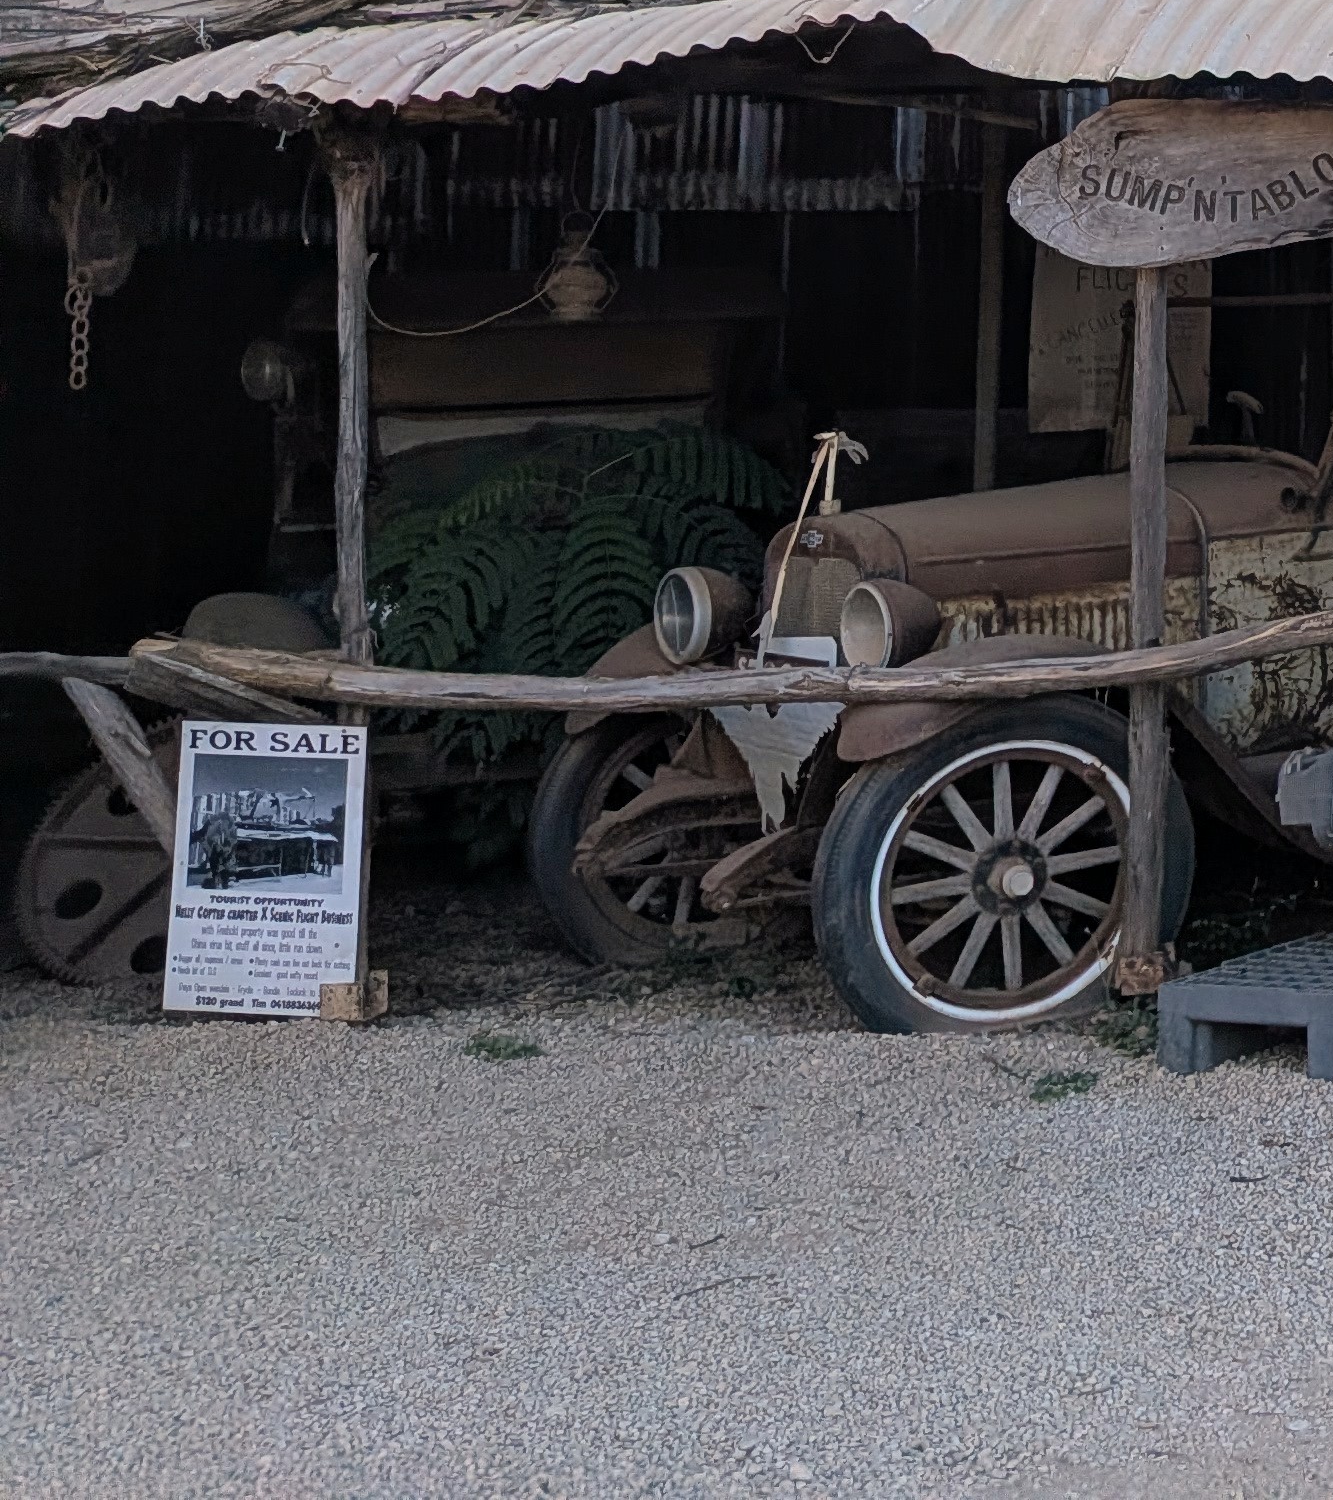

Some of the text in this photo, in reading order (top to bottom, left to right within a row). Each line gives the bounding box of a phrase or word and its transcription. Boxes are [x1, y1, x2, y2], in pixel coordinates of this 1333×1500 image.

[189, 729, 361, 754] FOR SALE
[210, 895, 251, 906] TOURIST
